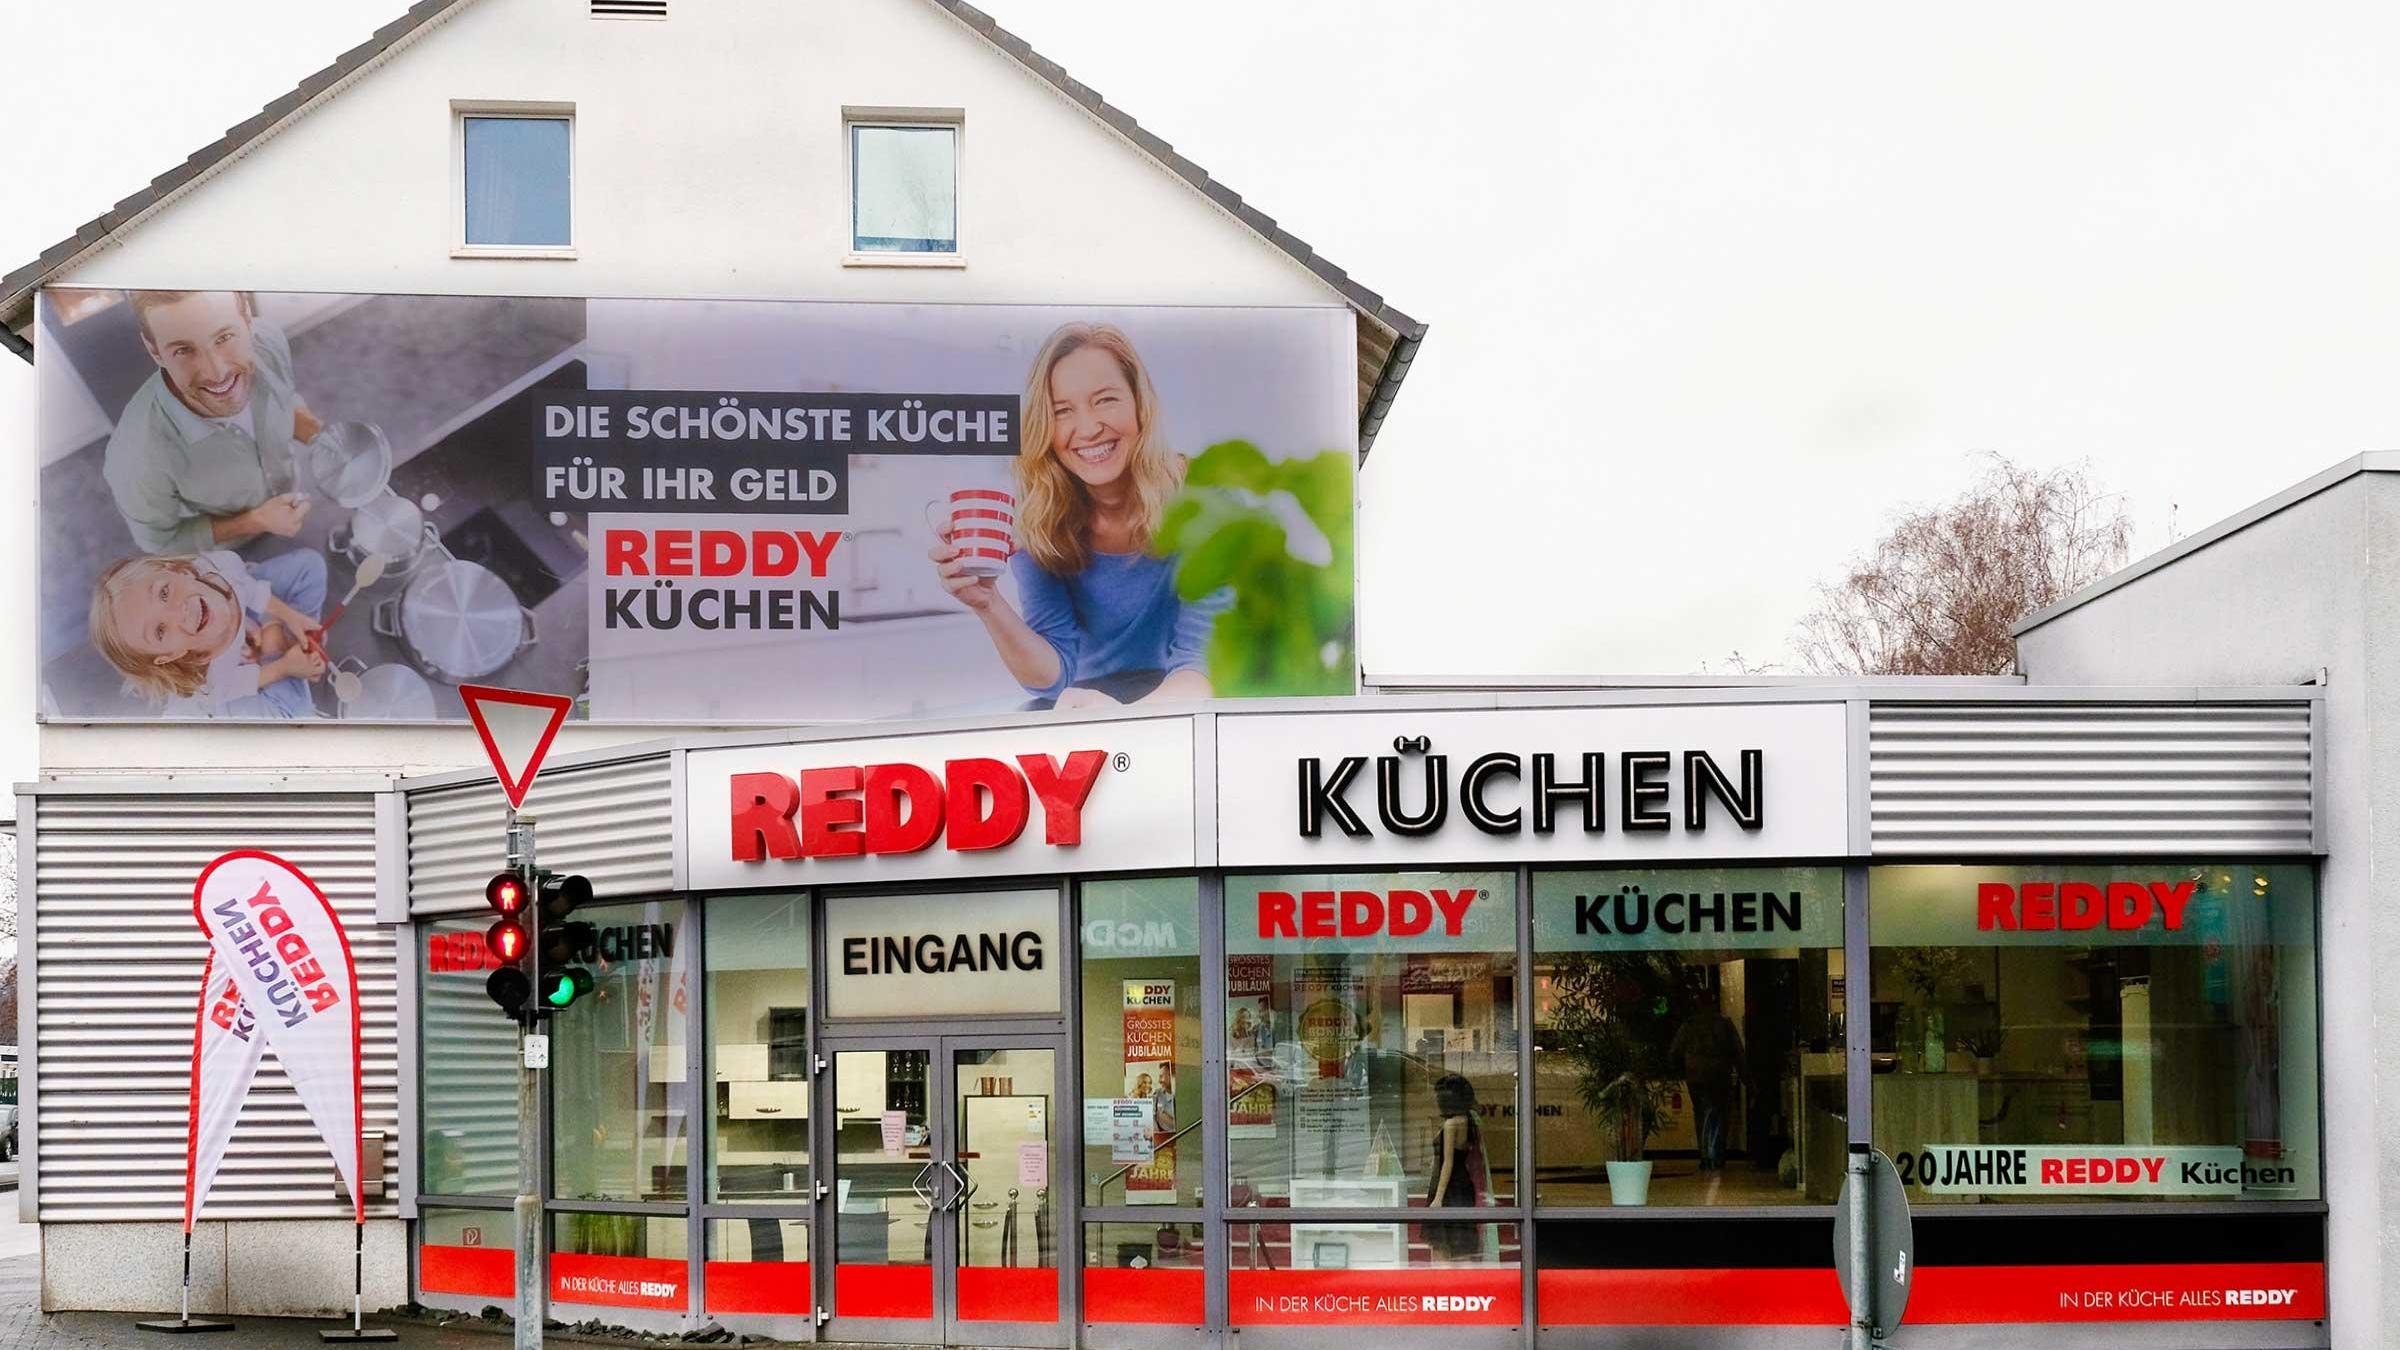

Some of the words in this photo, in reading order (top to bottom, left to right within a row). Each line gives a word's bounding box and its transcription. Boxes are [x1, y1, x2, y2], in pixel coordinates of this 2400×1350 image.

[545, 405, 610, 438] DIE
[626, 397, 851, 441] SCHÖNSTE
[868, 400, 1009, 442] KÜCHE
[545, 457, 627, 500] FÜR
[642, 467, 716, 500] IHR
[730, 467, 838, 501] GELD
[606, 580, 839, 630] KÜCHEN
[1299, 735, 1763, 837] KÜCHEN
[1575, 886, 1802, 934] KÜCHEN
[1978, 883, 2195, 931] REDDY
[844, 931, 1043, 975] EINGANG
[1127, 1042, 1172, 1057] JUBILÄUM
[1942, 1150, 2027, 1186] JAHRE
[2041, 1157, 2167, 1185] REDDY
[2181, 1161, 2295, 1185] Küchen
[561, 1277, 571, 1290] IN
[572, 1277, 587, 1291] DER
[588, 1277, 616, 1293] KÜCHE
[618, 1280, 639, 1295] ALLES
[640, 1282, 677, 1298] REDDY
[1255, 1296, 1274, 1312] IN
[1280, 1296, 1309, 1312] DER
[1314, 1294, 1370, 1312] KÜCHE
[1376, 1296, 1418, 1312] ALLES
[1422, 1296, 1494, 1312] REDDY
[2060, 1292, 2079, 1308] IN
[2084, 1292, 2113, 1308] DER
[2118, 1289, 2174, 1307] KÜCHE
[2179, 1290, 2221, 1306] ALLES
[2225, 1289, 2296, 1305] REDDY
